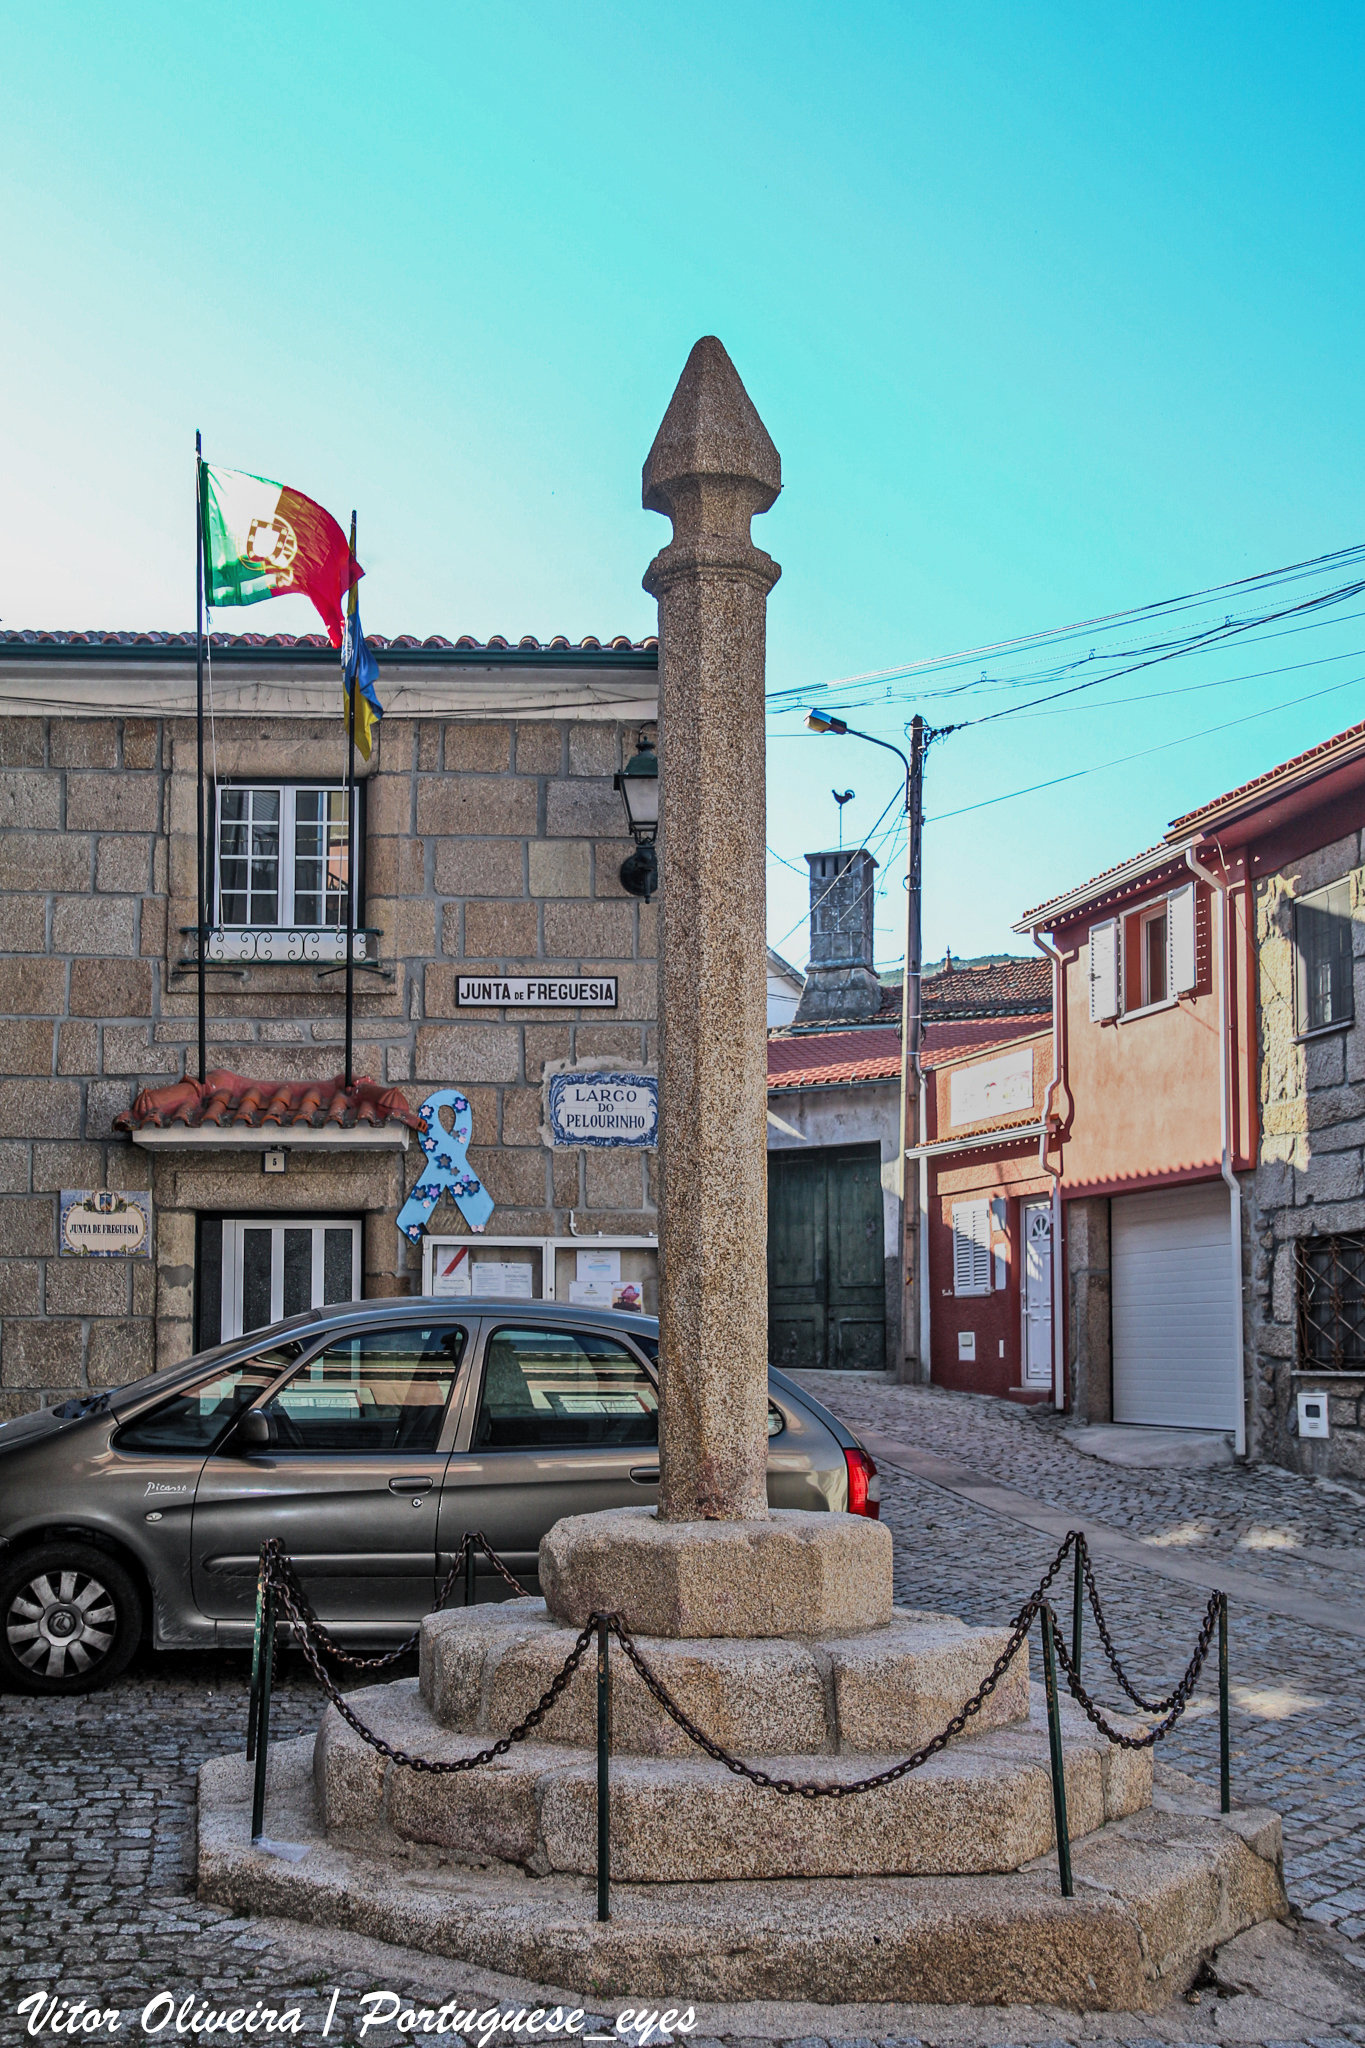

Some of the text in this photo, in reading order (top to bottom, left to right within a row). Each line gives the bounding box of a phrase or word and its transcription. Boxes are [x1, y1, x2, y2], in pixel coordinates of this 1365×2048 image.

[461, 983, 614, 1000] JUNTA DE FREGUESIA
[575, 1089, 637, 1102] LARGO
[598, 1103, 614, 1112] DO
[566, 1114, 646, 1128] PELOURINHO
[272, 1157, 277, 1166] 5
[70, 1224, 139, 1234] JUNTA DE FREGUESIA
[143, 1481, 187, 1497] Picasso
